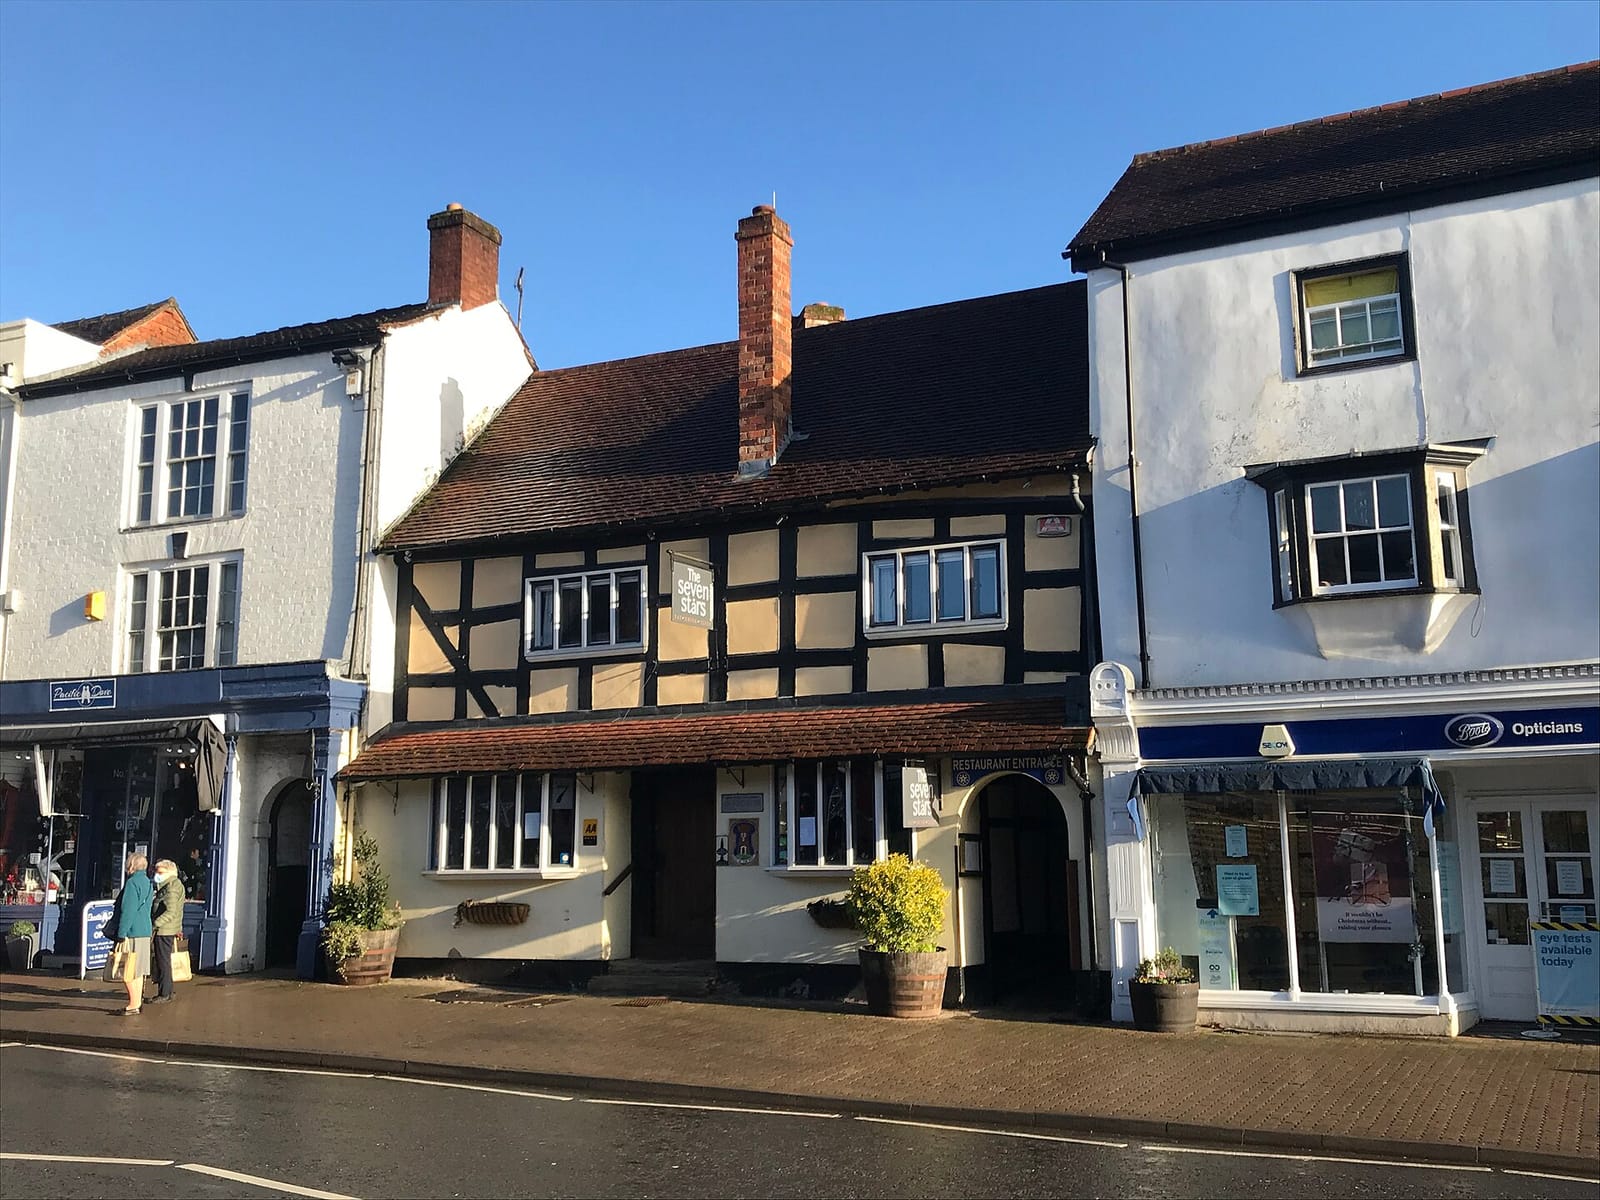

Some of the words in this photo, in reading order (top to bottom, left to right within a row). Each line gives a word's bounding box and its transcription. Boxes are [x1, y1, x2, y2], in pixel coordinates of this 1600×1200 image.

[687, 568, 701, 583] The
[677, 579, 709, 601] seven
[681, 596, 706, 617] stars
[53, 686, 81, 699] Pacific
[1456, 721, 1491, 741] Boots
[1511, 721, 1584, 737] Opticians
[952, 758, 1011, 771] RESTAURANT
[910, 783, 934, 799] seven
[912, 799, 932, 817] stars
[1540, 934, 1560, 944] eye
[1562, 933, 1593, 944] tests
[1540, 945, 1593, 955] available
[1541, 956, 1574, 969] today
